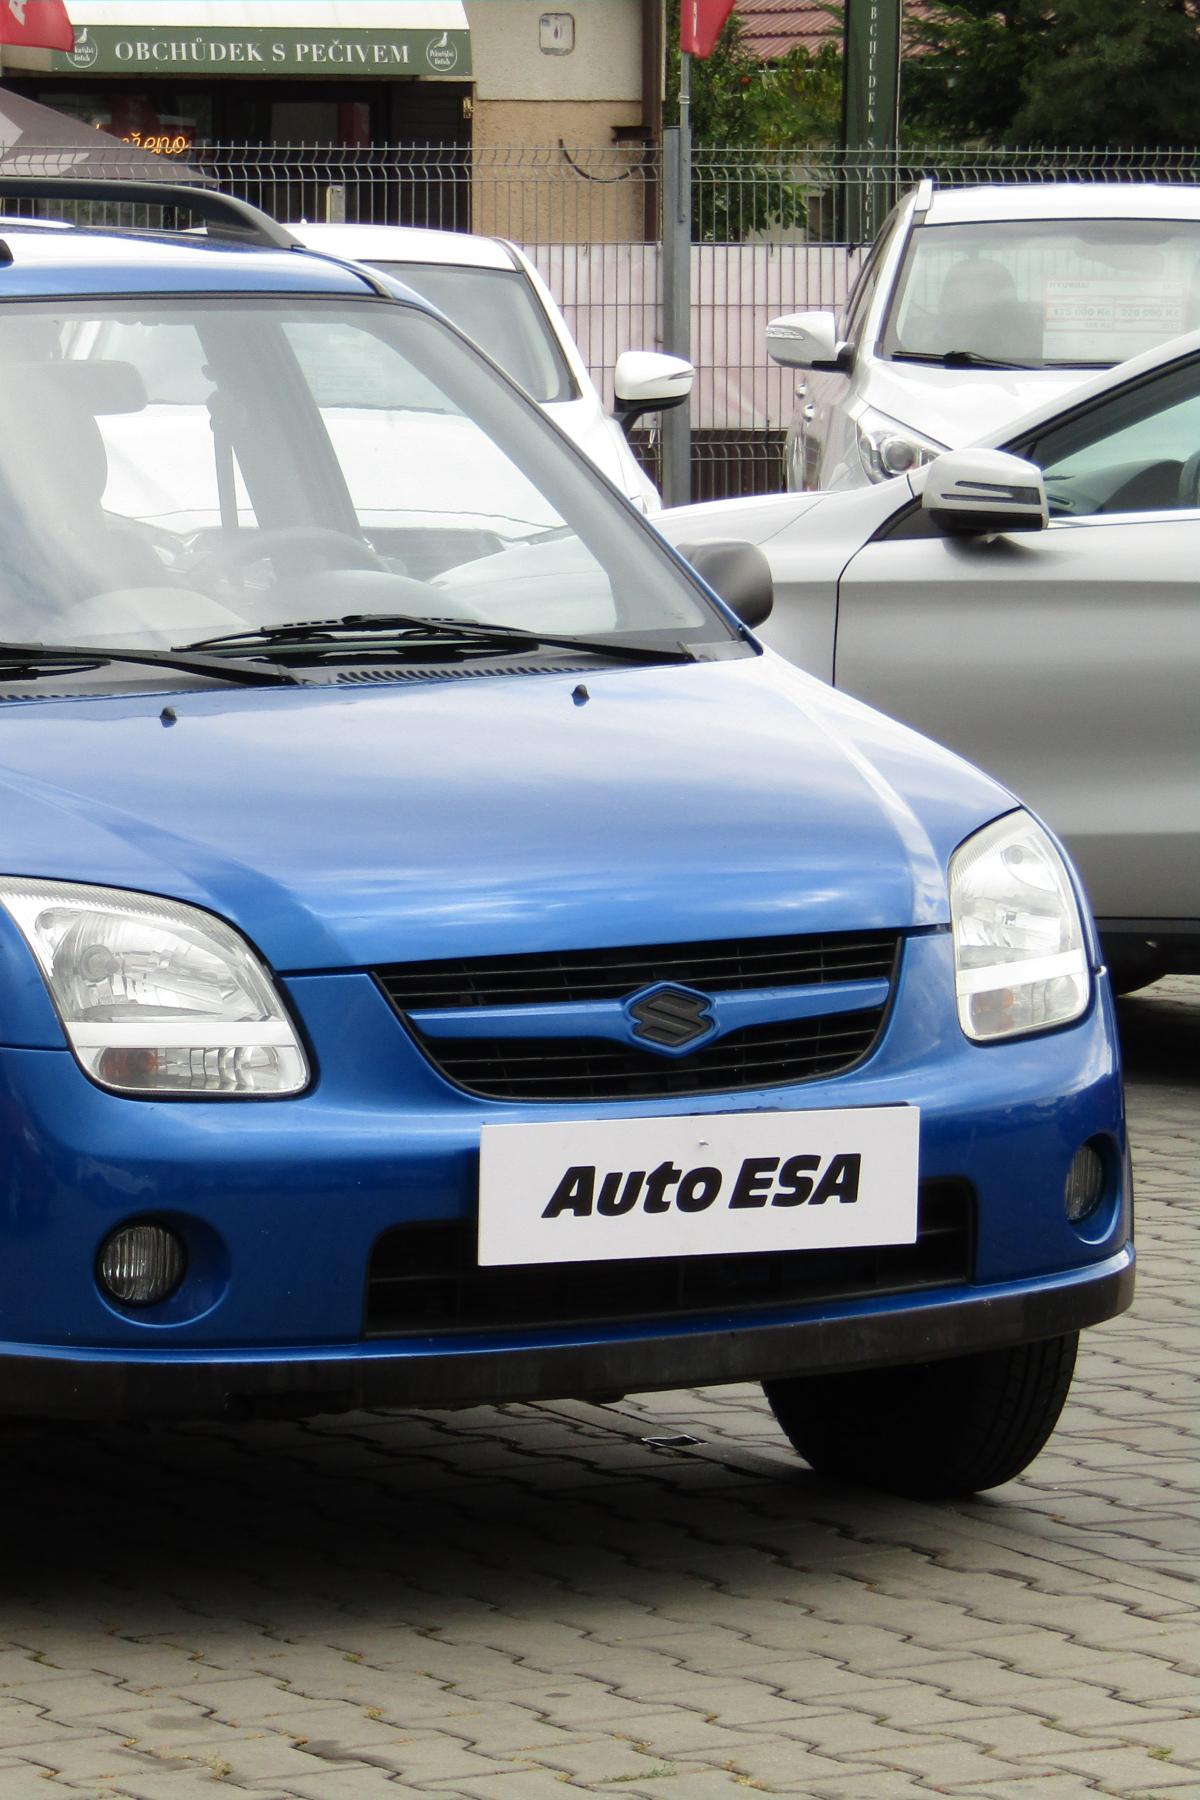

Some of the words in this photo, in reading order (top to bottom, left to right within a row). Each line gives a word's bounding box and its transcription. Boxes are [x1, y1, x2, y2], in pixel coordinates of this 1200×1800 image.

[114, 36, 264, 63] OBCHŮDEK
[271, 43, 287, 63] S
[295, 38, 410, 65] PEČIVEM
[541, 1161, 723, 1219] Auto
[728, 1153, 861, 1209] ESA
